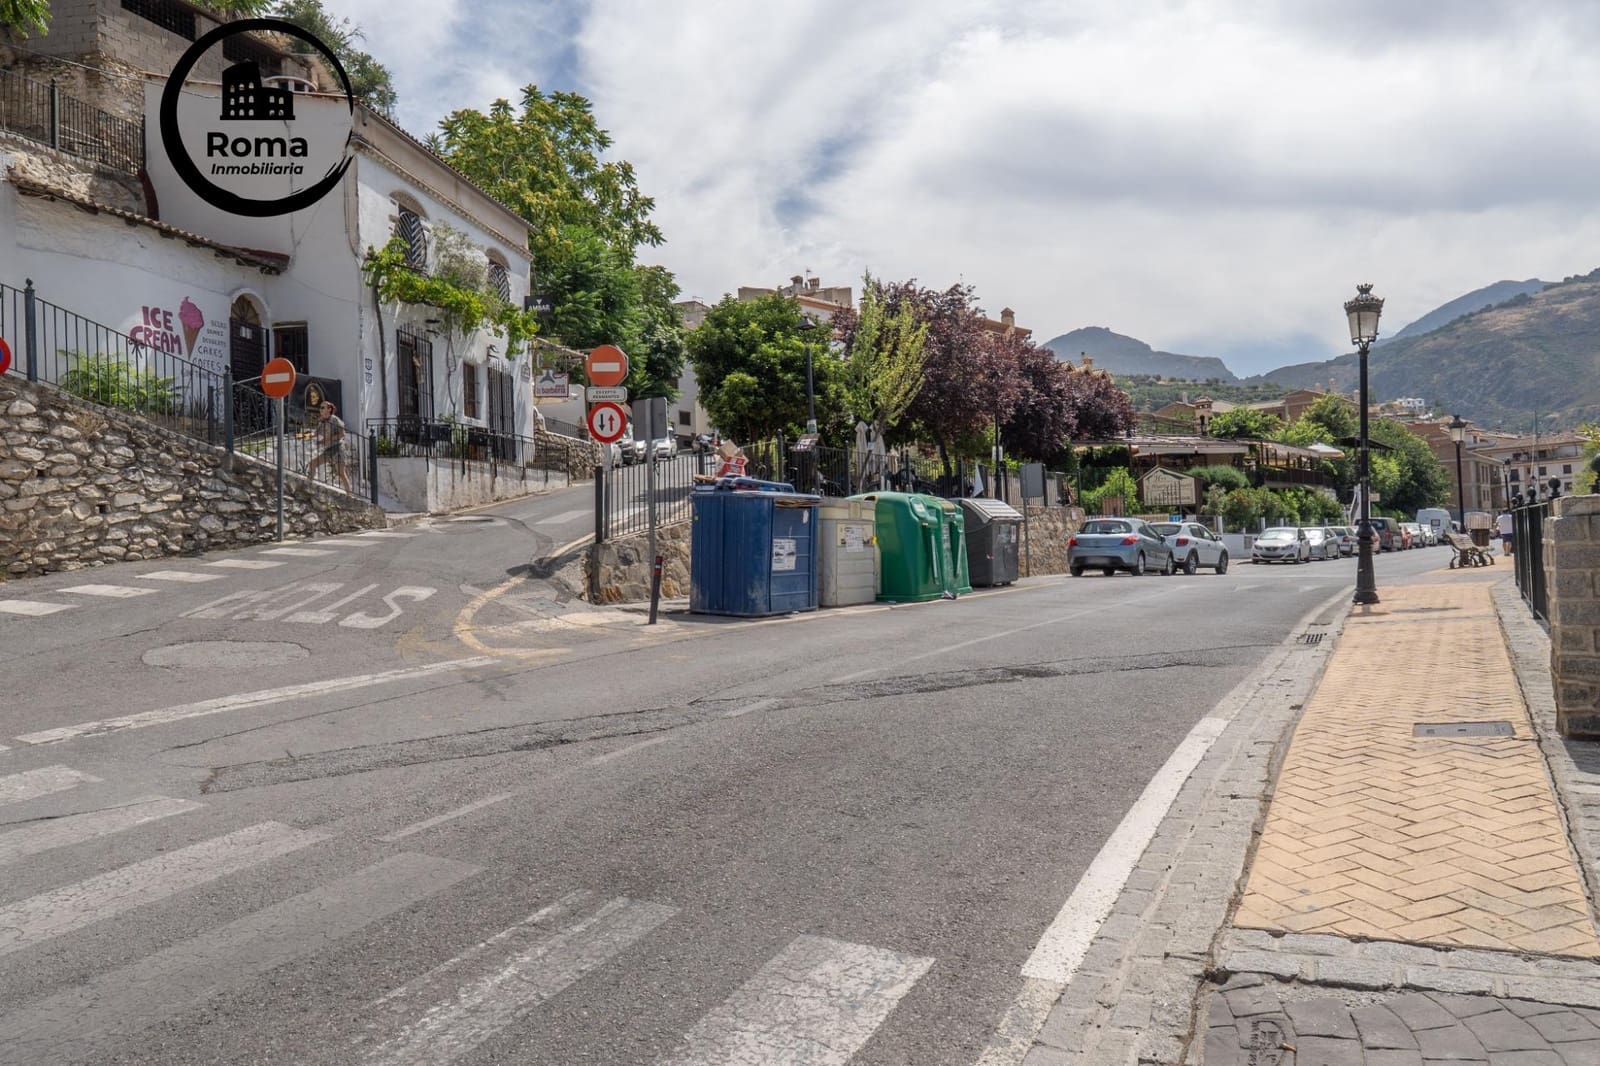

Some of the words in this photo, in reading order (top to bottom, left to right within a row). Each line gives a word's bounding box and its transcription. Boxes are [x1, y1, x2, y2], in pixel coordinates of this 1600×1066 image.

[142, 306, 173, 332] ICE
[129, 325, 182, 356] CREAM
[197, 345, 223, 358] CAKES
